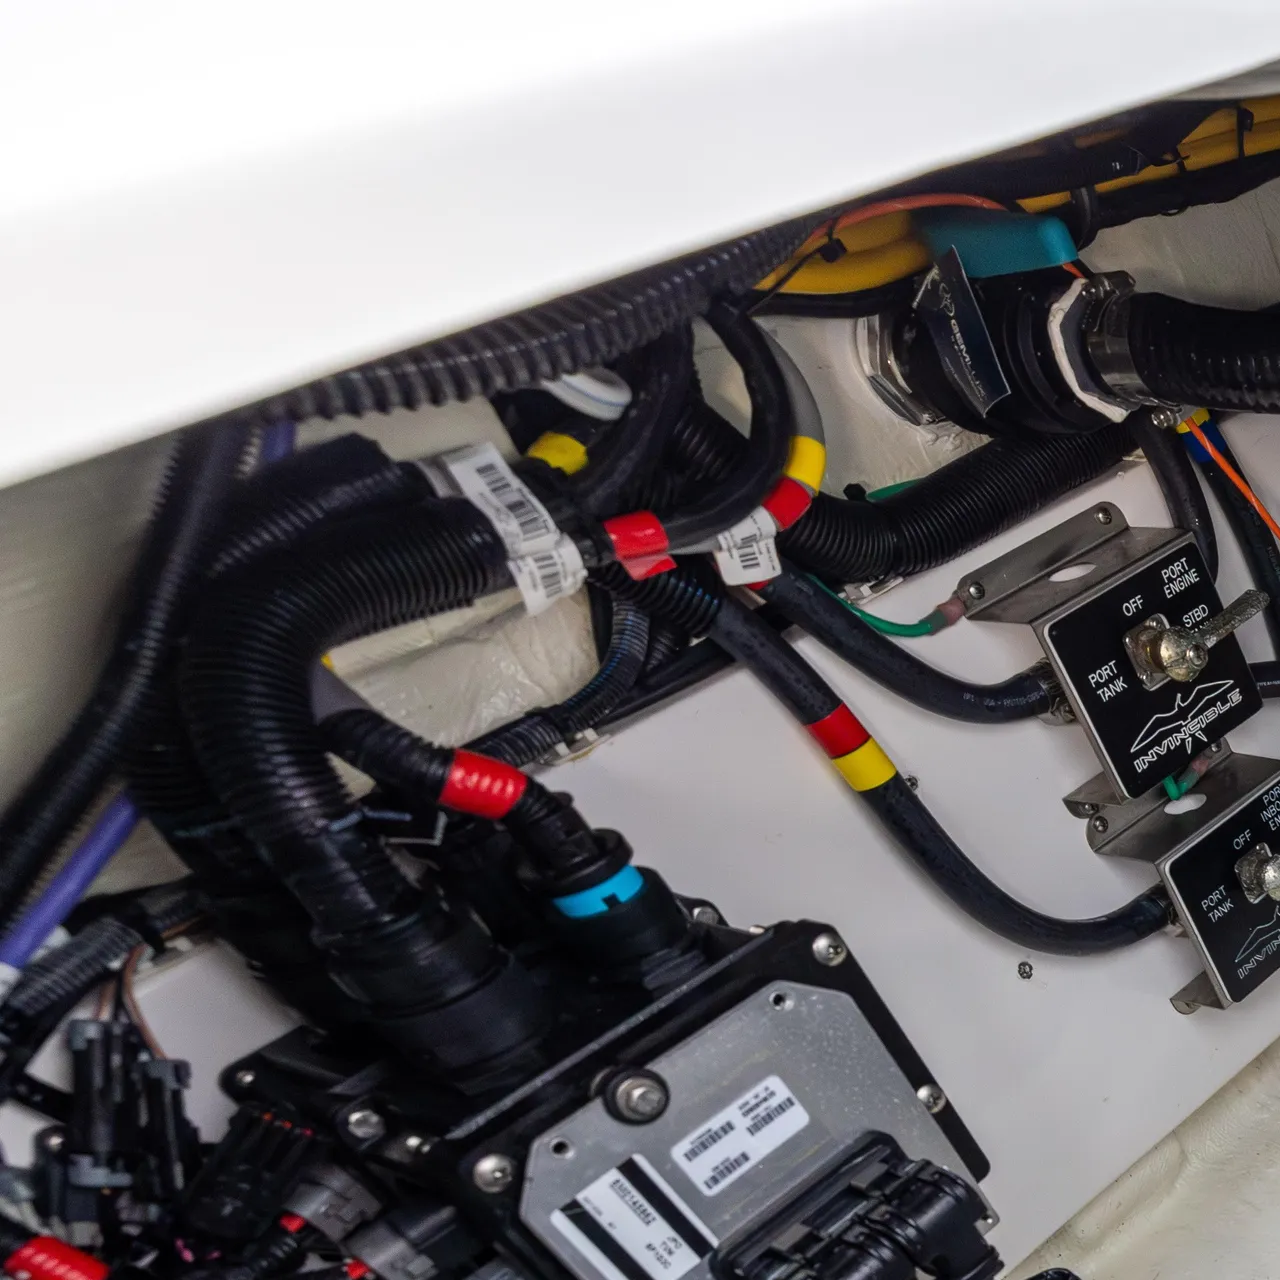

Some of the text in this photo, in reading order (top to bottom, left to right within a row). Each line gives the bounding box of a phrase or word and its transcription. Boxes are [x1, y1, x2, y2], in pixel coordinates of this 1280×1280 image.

[1161, 557, 1189, 583] PORT
[1163, 568, 1200, 599] ENGINE
[1122, 595, 1143, 616] OFF
[1182, 604, 1209, 628] STBD
[1088, 660, 1118, 688] PORT
[1096, 676, 1128, 702] TANK
[1133, 688, 1243, 773] INVINCIBLE
[1233, 829, 1251, 850] OFF
[1201, 885, 1228, 911] PORT
[1208, 898, 1234, 923] TANK
